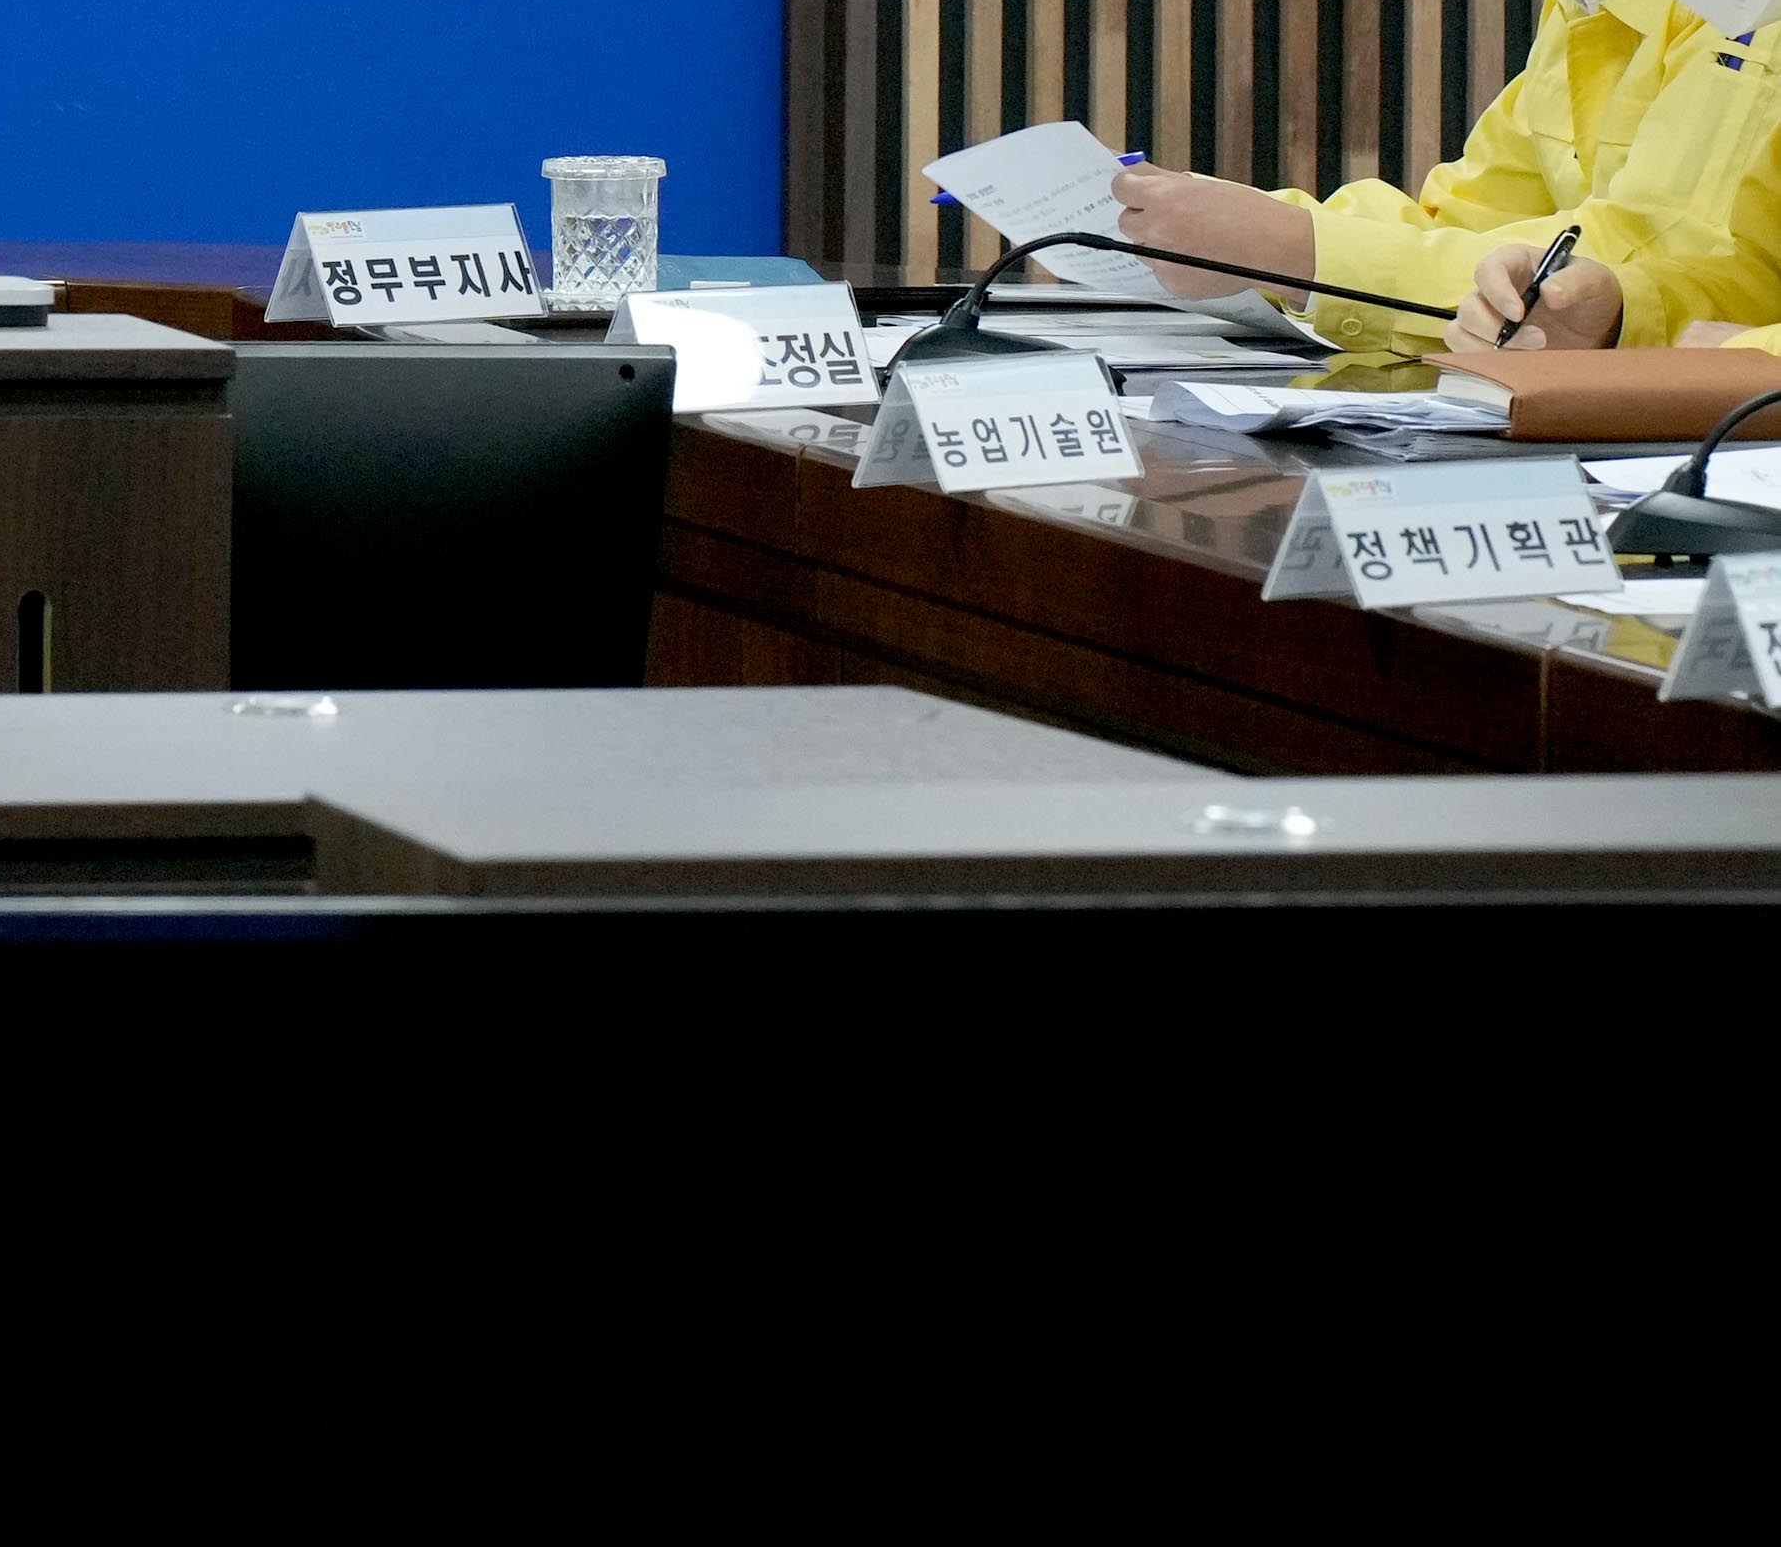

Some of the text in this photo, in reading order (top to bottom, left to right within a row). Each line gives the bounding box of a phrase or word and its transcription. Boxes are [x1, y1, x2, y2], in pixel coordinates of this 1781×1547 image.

[322, 250, 531, 306] 정무부지사
[931, 408, 1124, 469] 농업기술원
[1347, 515, 1606, 581] 정책기획관
